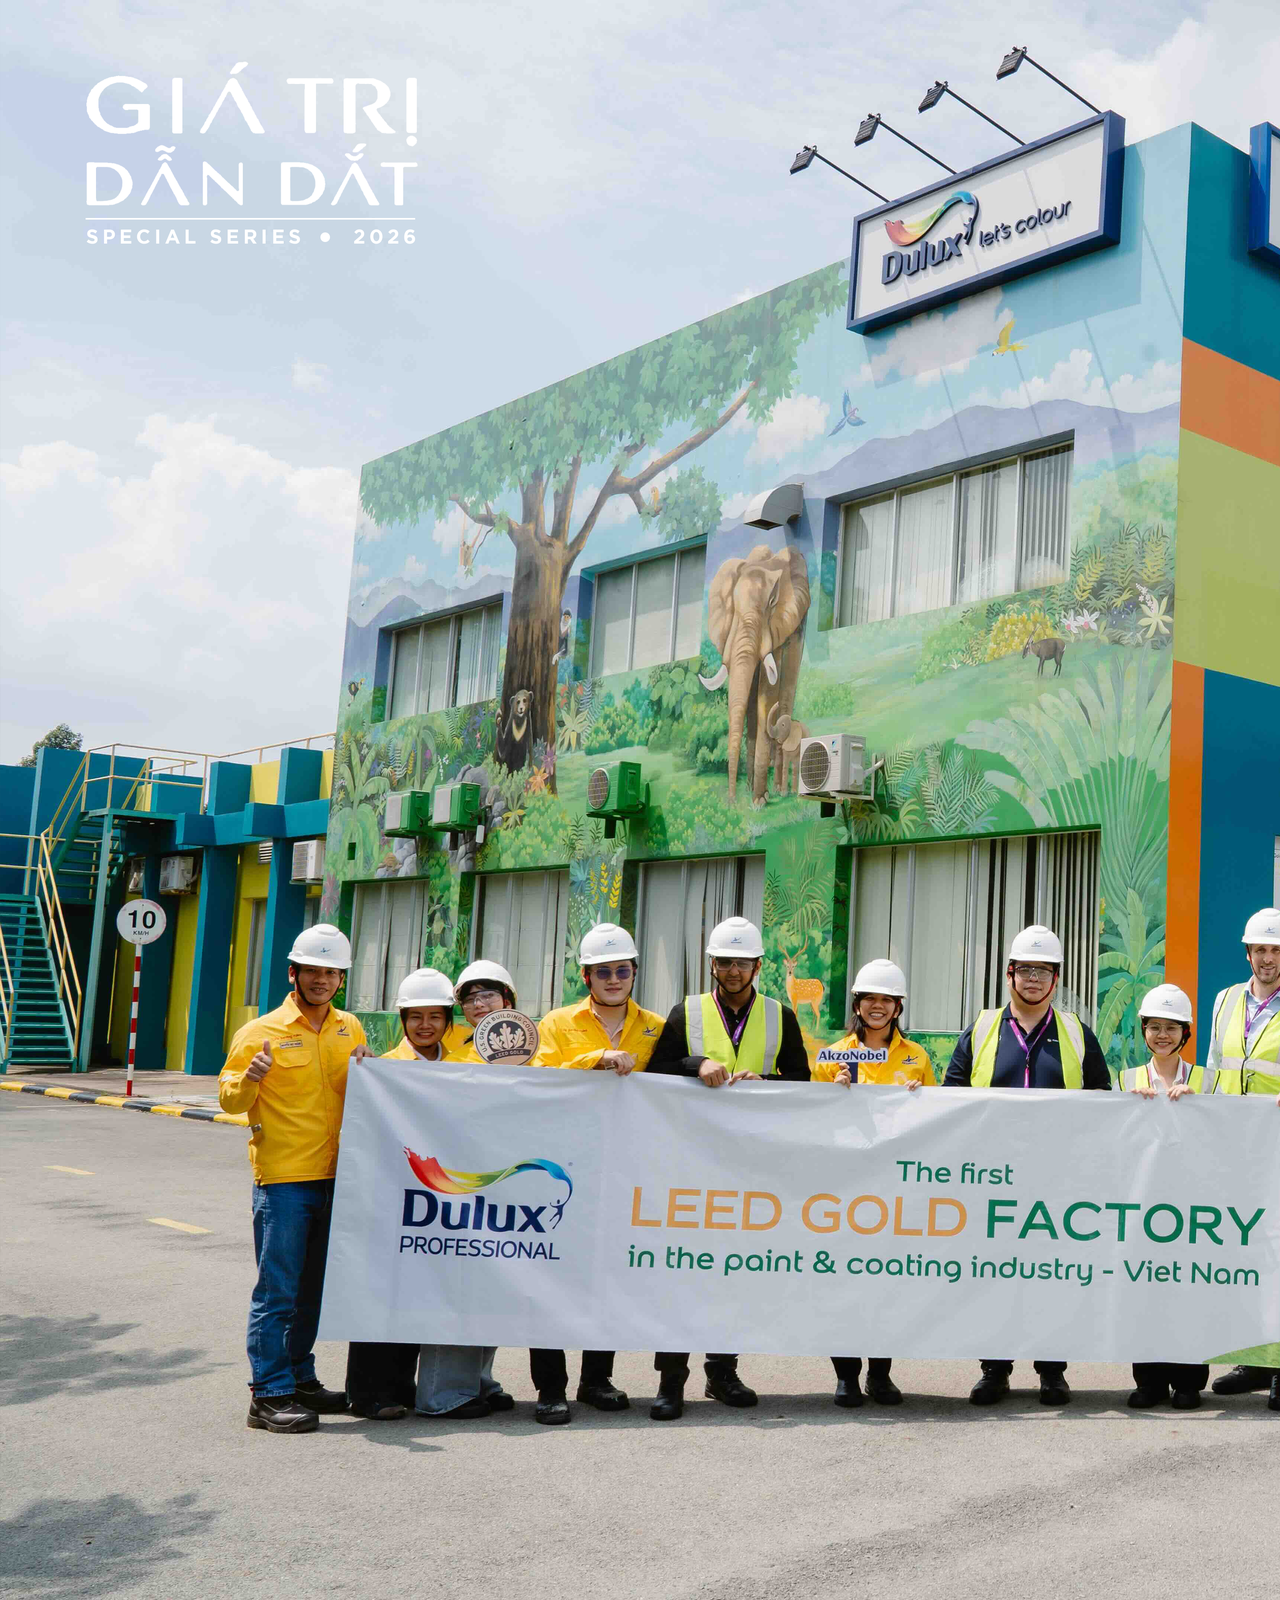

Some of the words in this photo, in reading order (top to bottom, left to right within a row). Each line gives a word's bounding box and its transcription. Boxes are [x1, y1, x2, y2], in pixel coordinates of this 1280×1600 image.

[881, 231, 964, 285] Dulux
[979, 223, 1012, 248] let's
[1014, 200, 1072, 236] colour
[128, 910, 156, 929] 10
[479, 1020, 492, 1042] GREEN
[491, 1013, 523, 1025] BUILDING
[522, 1019, 534, 1047] COUNCIL
[818, 1050, 886, 1061] AkzoNobel
[896, 1160, 951, 1184] The
[961, 1162, 1014, 1185] first
[402, 1188, 548, 1233] Dulux
[630, 1186, 783, 1232] LEED
[801, 1193, 967, 1237] GOLD
[986, 1198, 1267, 1246] FACTORY
[399, 1235, 561, 1260] PROFESSIONAL
[628, 1244, 655, 1268] in
[666, 1246, 715, 1270] the
[724, 1249, 803, 1276] paint
[812, 1250, 837, 1275] &
[846, 1254, 962, 1284] coating
[971, 1255, 1093, 1287] industry
[1123, 1260, 1182, 1283] Viet
[1190, 1261, 1260, 1286] Nam
